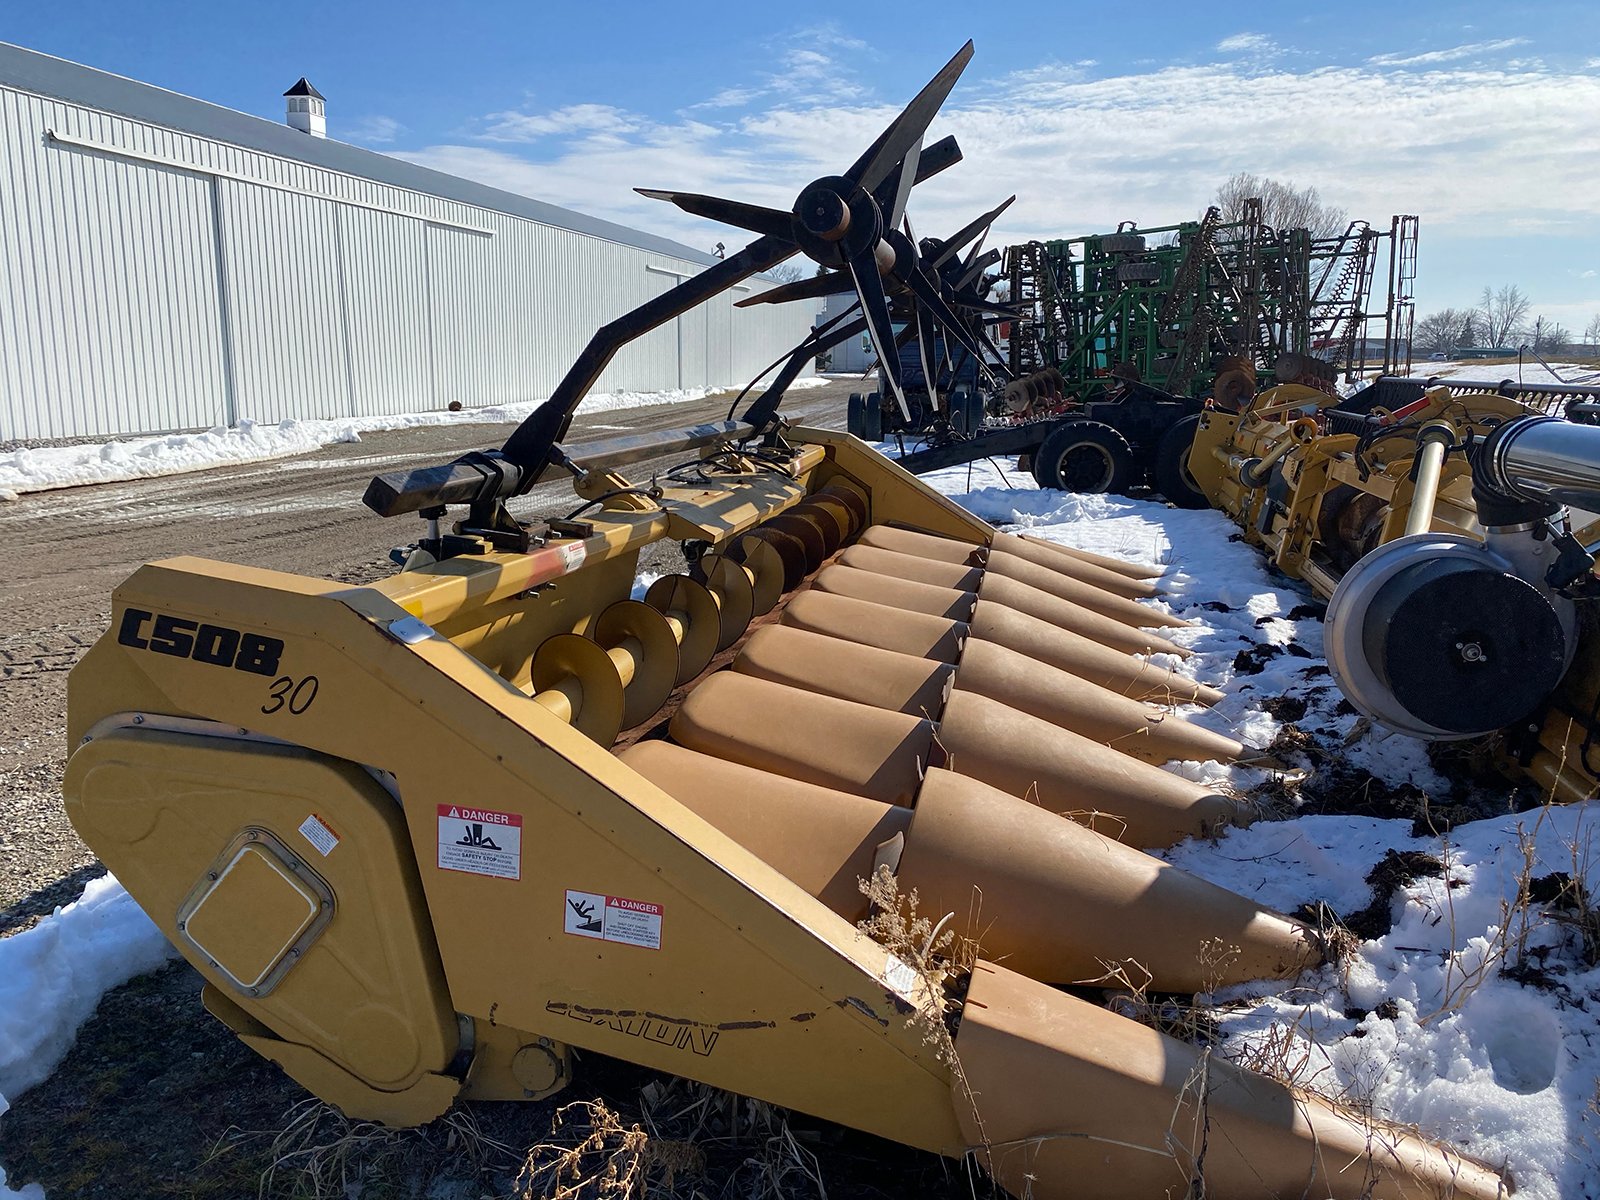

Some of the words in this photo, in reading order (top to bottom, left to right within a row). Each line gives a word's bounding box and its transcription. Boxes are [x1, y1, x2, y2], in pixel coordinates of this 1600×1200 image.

[118, 608, 284, 677] C508
[261, 675, 319, 715] 30
[462, 809, 509, 824] DANGER
[462, 852, 481, 860] SAFETY
[621, 900, 658, 913] DANGER
